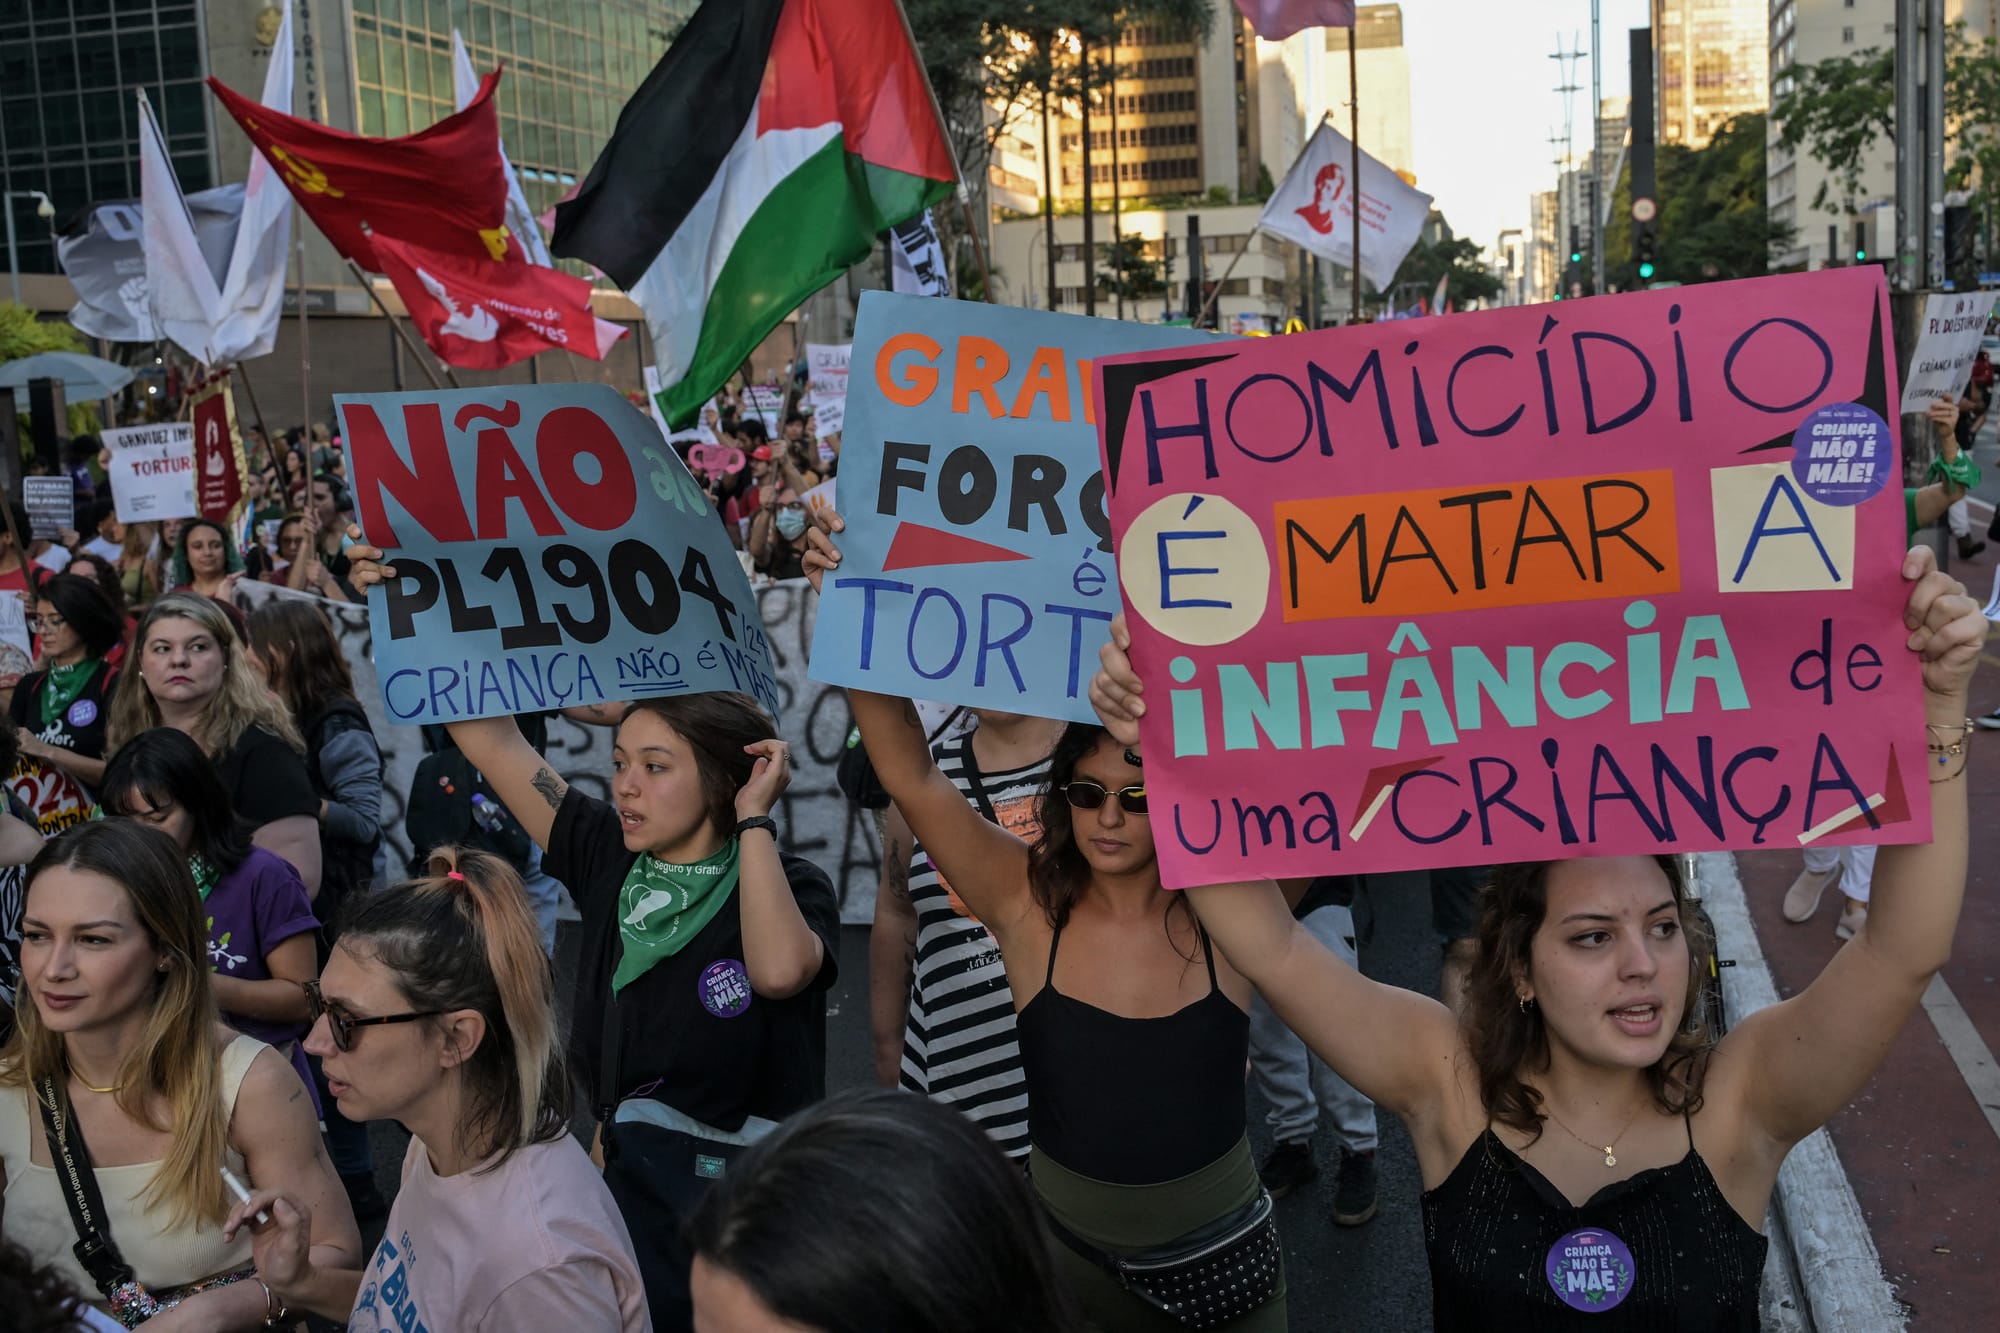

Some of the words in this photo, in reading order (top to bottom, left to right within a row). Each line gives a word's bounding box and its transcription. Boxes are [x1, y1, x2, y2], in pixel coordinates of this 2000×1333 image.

[1809, 437, 1858, 458] NÃO
[1861, 436, 1877, 457] É
[1812, 423, 1877, 438] CRIANÇA
[342, 400, 637, 548] NÃO
[642, 447, 707, 517] ao
[1806, 458, 1876, 484] MÃE!
[1157, 495, 1232, 608] É
[1286, 480, 1664, 608] MATAR
[1733, 475, 1841, 584] A
[1073, 547, 1106, 596] é
[616, 647, 680, 682] NÃO
[1790, 618, 1883, 705] de
[654, 860, 684, 874] Seguro
[686, 866, 693, 876] y
[45, 1079, 58, 1112] OLORIDO
[65, 1153, 81, 1191] COLORIDO
[75, 1189, 88, 1211] PELO
[82, 1208, 92, 1225] SOL
[381, 1260, 430, 1333] BEA
